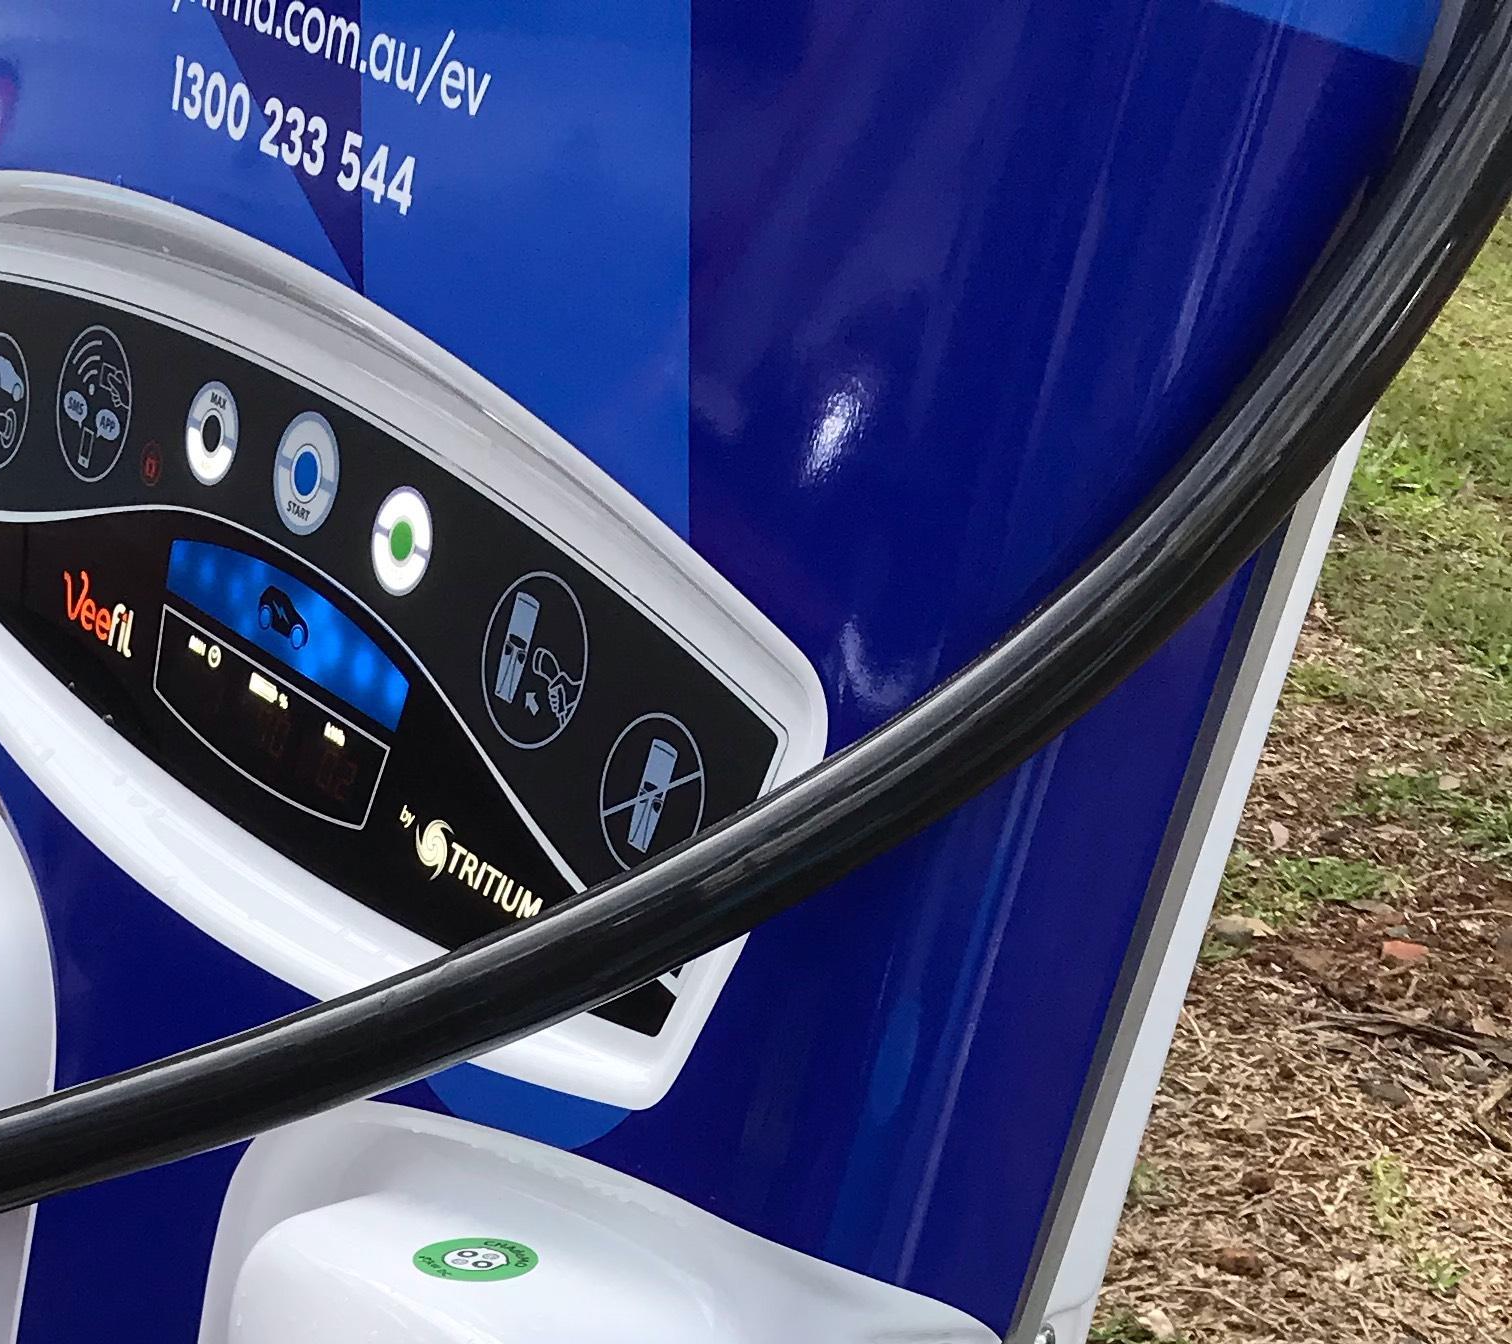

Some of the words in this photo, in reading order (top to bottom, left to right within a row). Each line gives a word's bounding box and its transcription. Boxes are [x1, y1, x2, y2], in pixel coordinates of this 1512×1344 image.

[171, 55, 251, 141] 1300
[259, 97, 329, 177] 233
[336, 130, 416, 216] 544
[66, 396, 85, 416] SMS
[210, 391, 228, 411] MAX
[99, 415, 116, 433] APP
[286, 500, 311, 522] START
[64, 570, 133, 658] Veefil
[399, 804, 416, 829] by
[447, 841, 544, 919] TRITIUM
